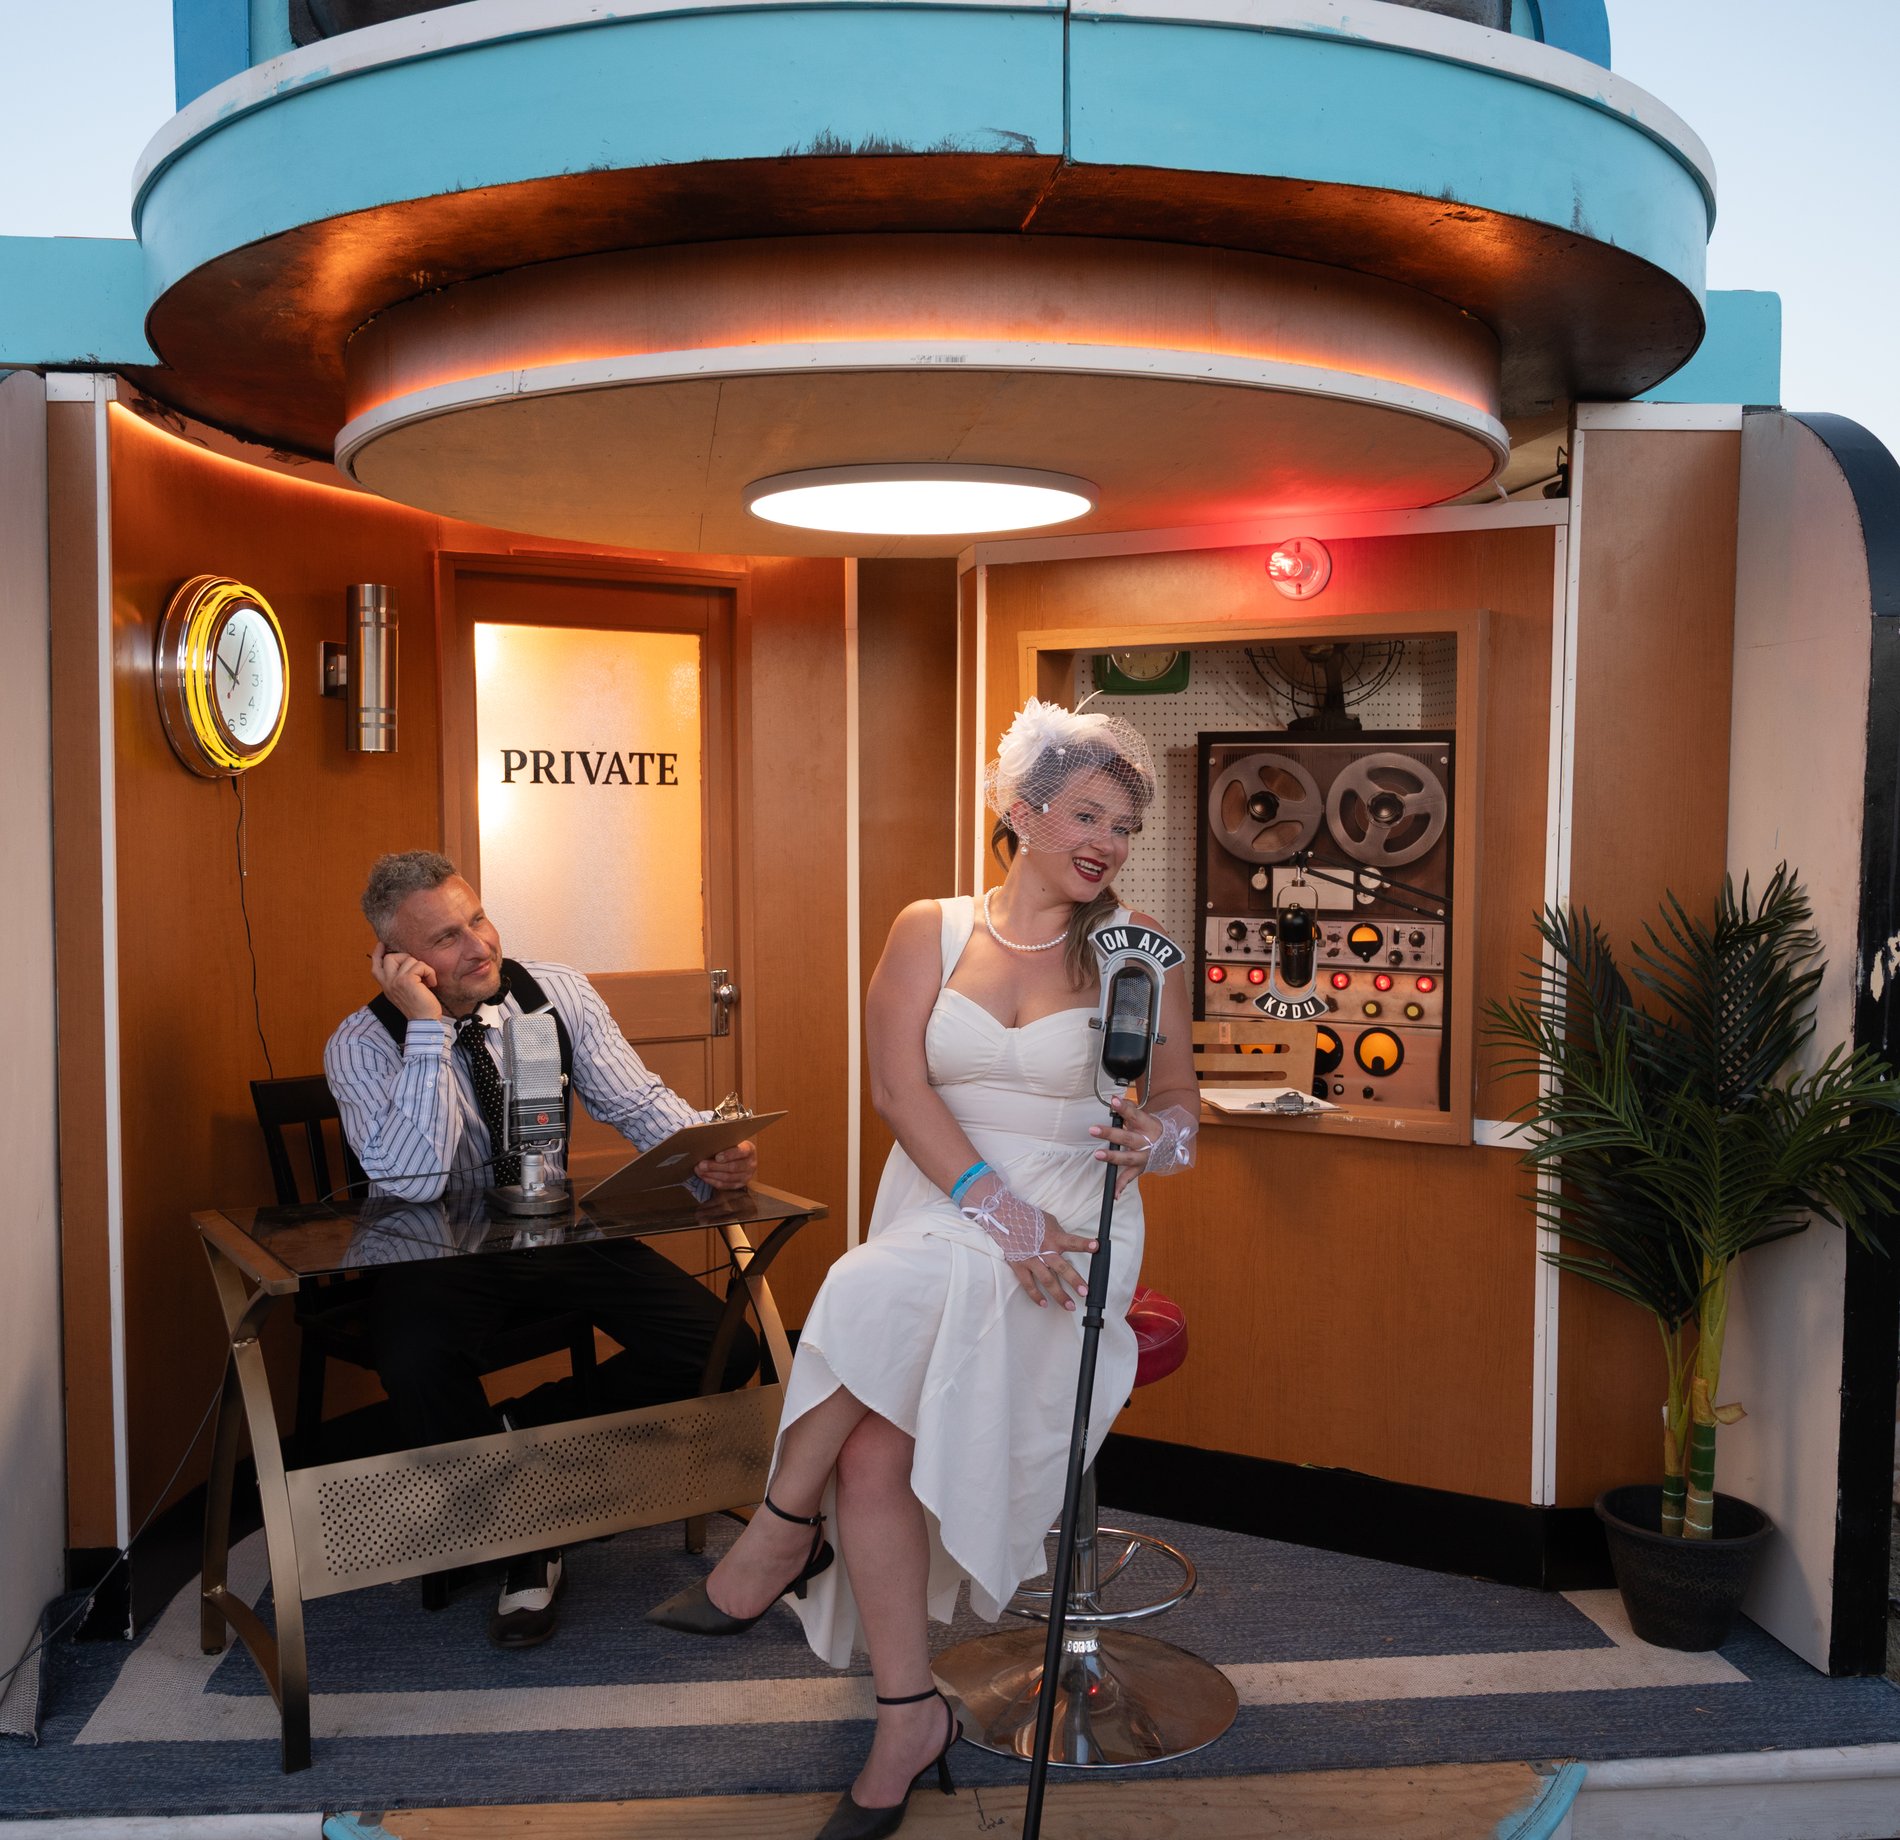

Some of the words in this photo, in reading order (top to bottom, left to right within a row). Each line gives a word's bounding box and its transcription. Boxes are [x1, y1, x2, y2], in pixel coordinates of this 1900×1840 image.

[248, 650, 256, 663] 2
[251, 673, 259, 688] 3
[248, 695, 255, 709] 4
[227, 718, 236, 732] 6
[239, 712, 247, 726] 5
[500, 749, 679, 786] PRIVATE
[1102, 929, 1129, 951] ON
[1137, 932, 1173, 964] AIR
[1263, 996, 1316, 1019] KBDU
